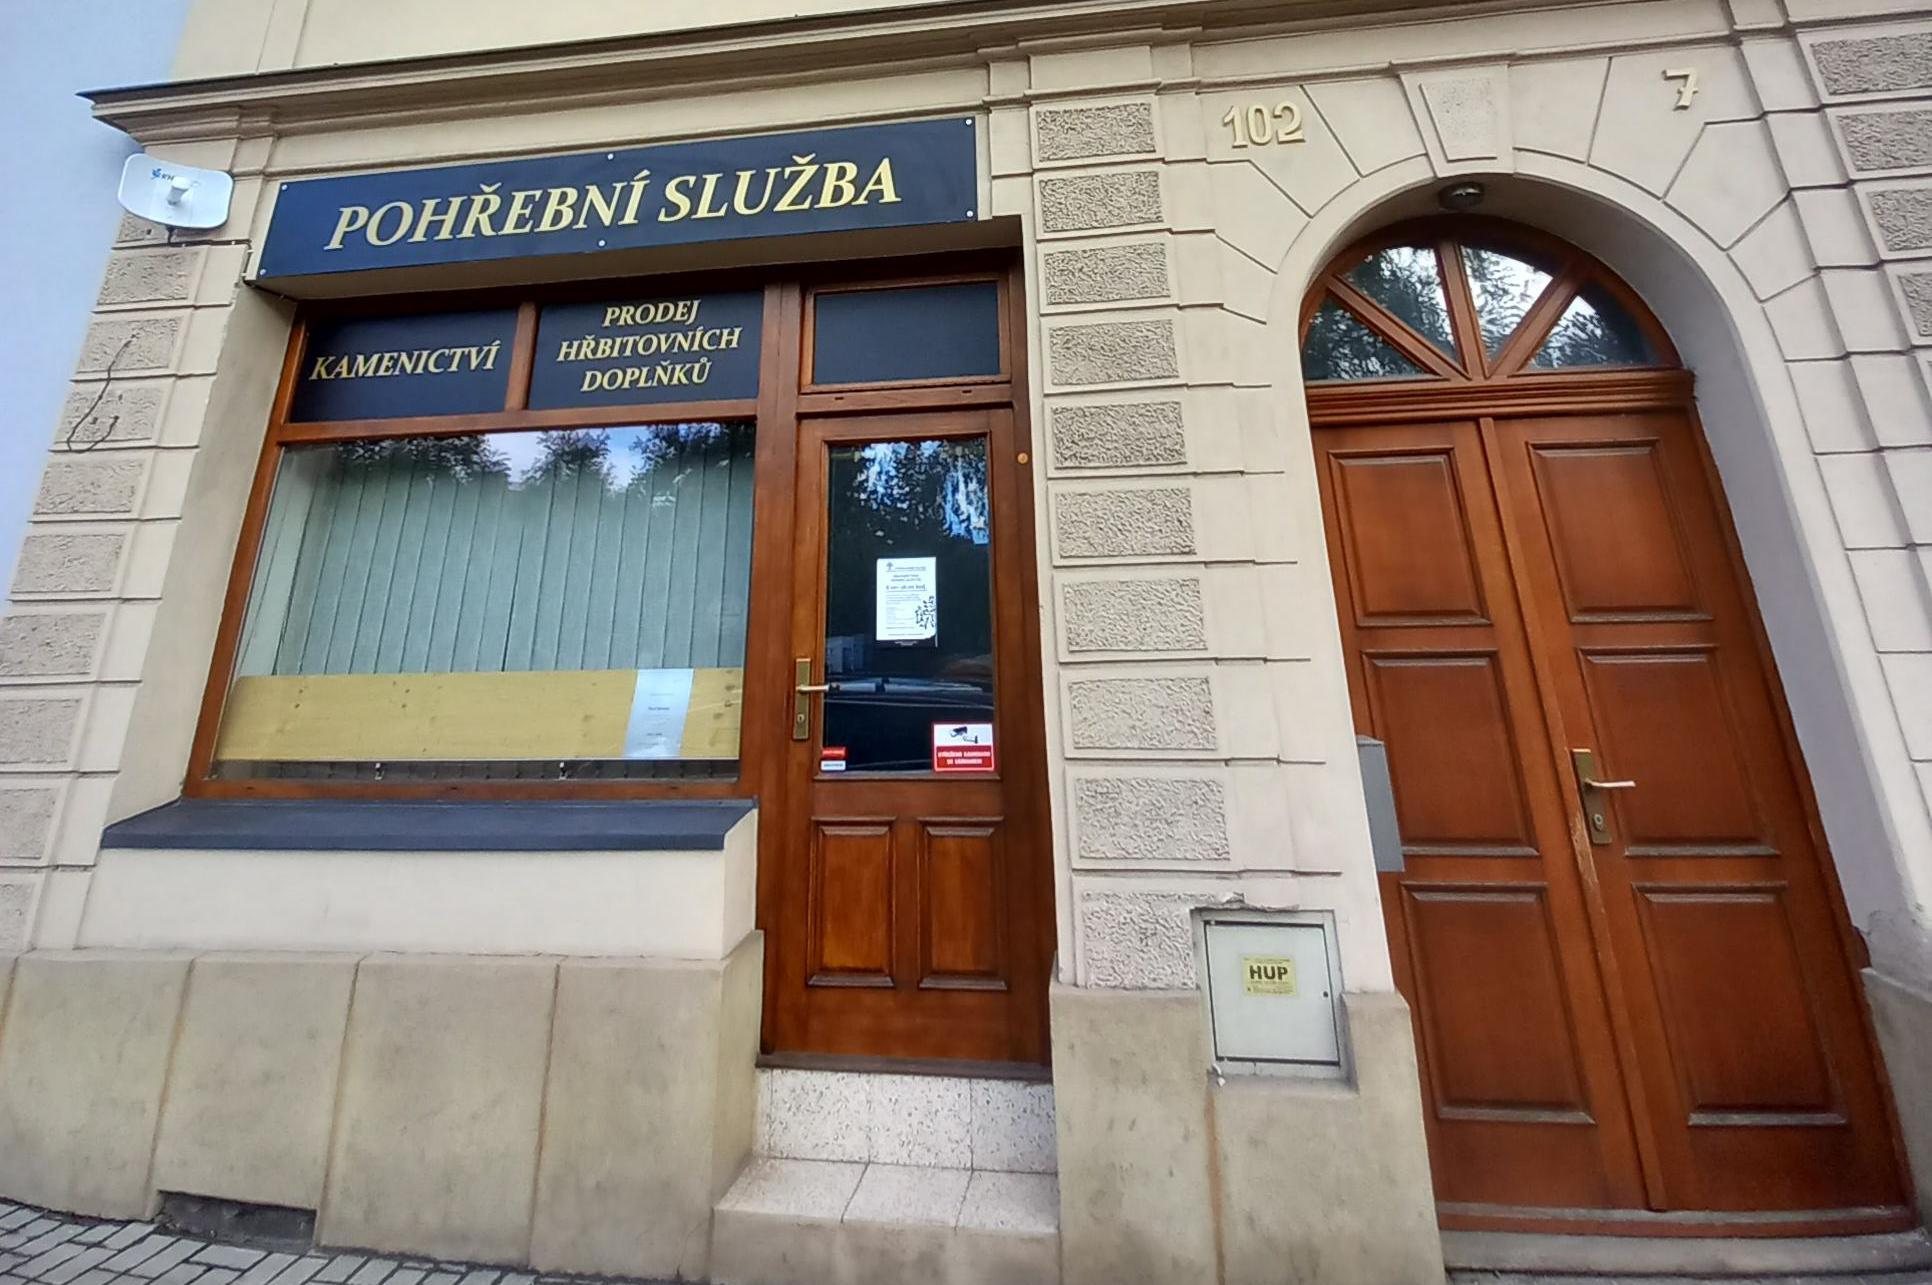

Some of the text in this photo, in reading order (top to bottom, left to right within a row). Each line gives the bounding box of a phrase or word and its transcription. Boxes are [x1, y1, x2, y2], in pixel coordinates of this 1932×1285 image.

[1662, 69, 1699, 111] 7
[1223, 100, 1306, 149] 102
[323, 153, 902, 251] POHŘEBNÍ SLUŽBA
[602, 299, 702, 328] PRODEJ
[308, 339, 501, 381] KAMENICTVÍ
[556, 324, 743, 362] HŘBITOVNÍCH
[580, 355, 713, 393] DOPLŇKŮ
[1249, 965, 1288, 980] HUP
